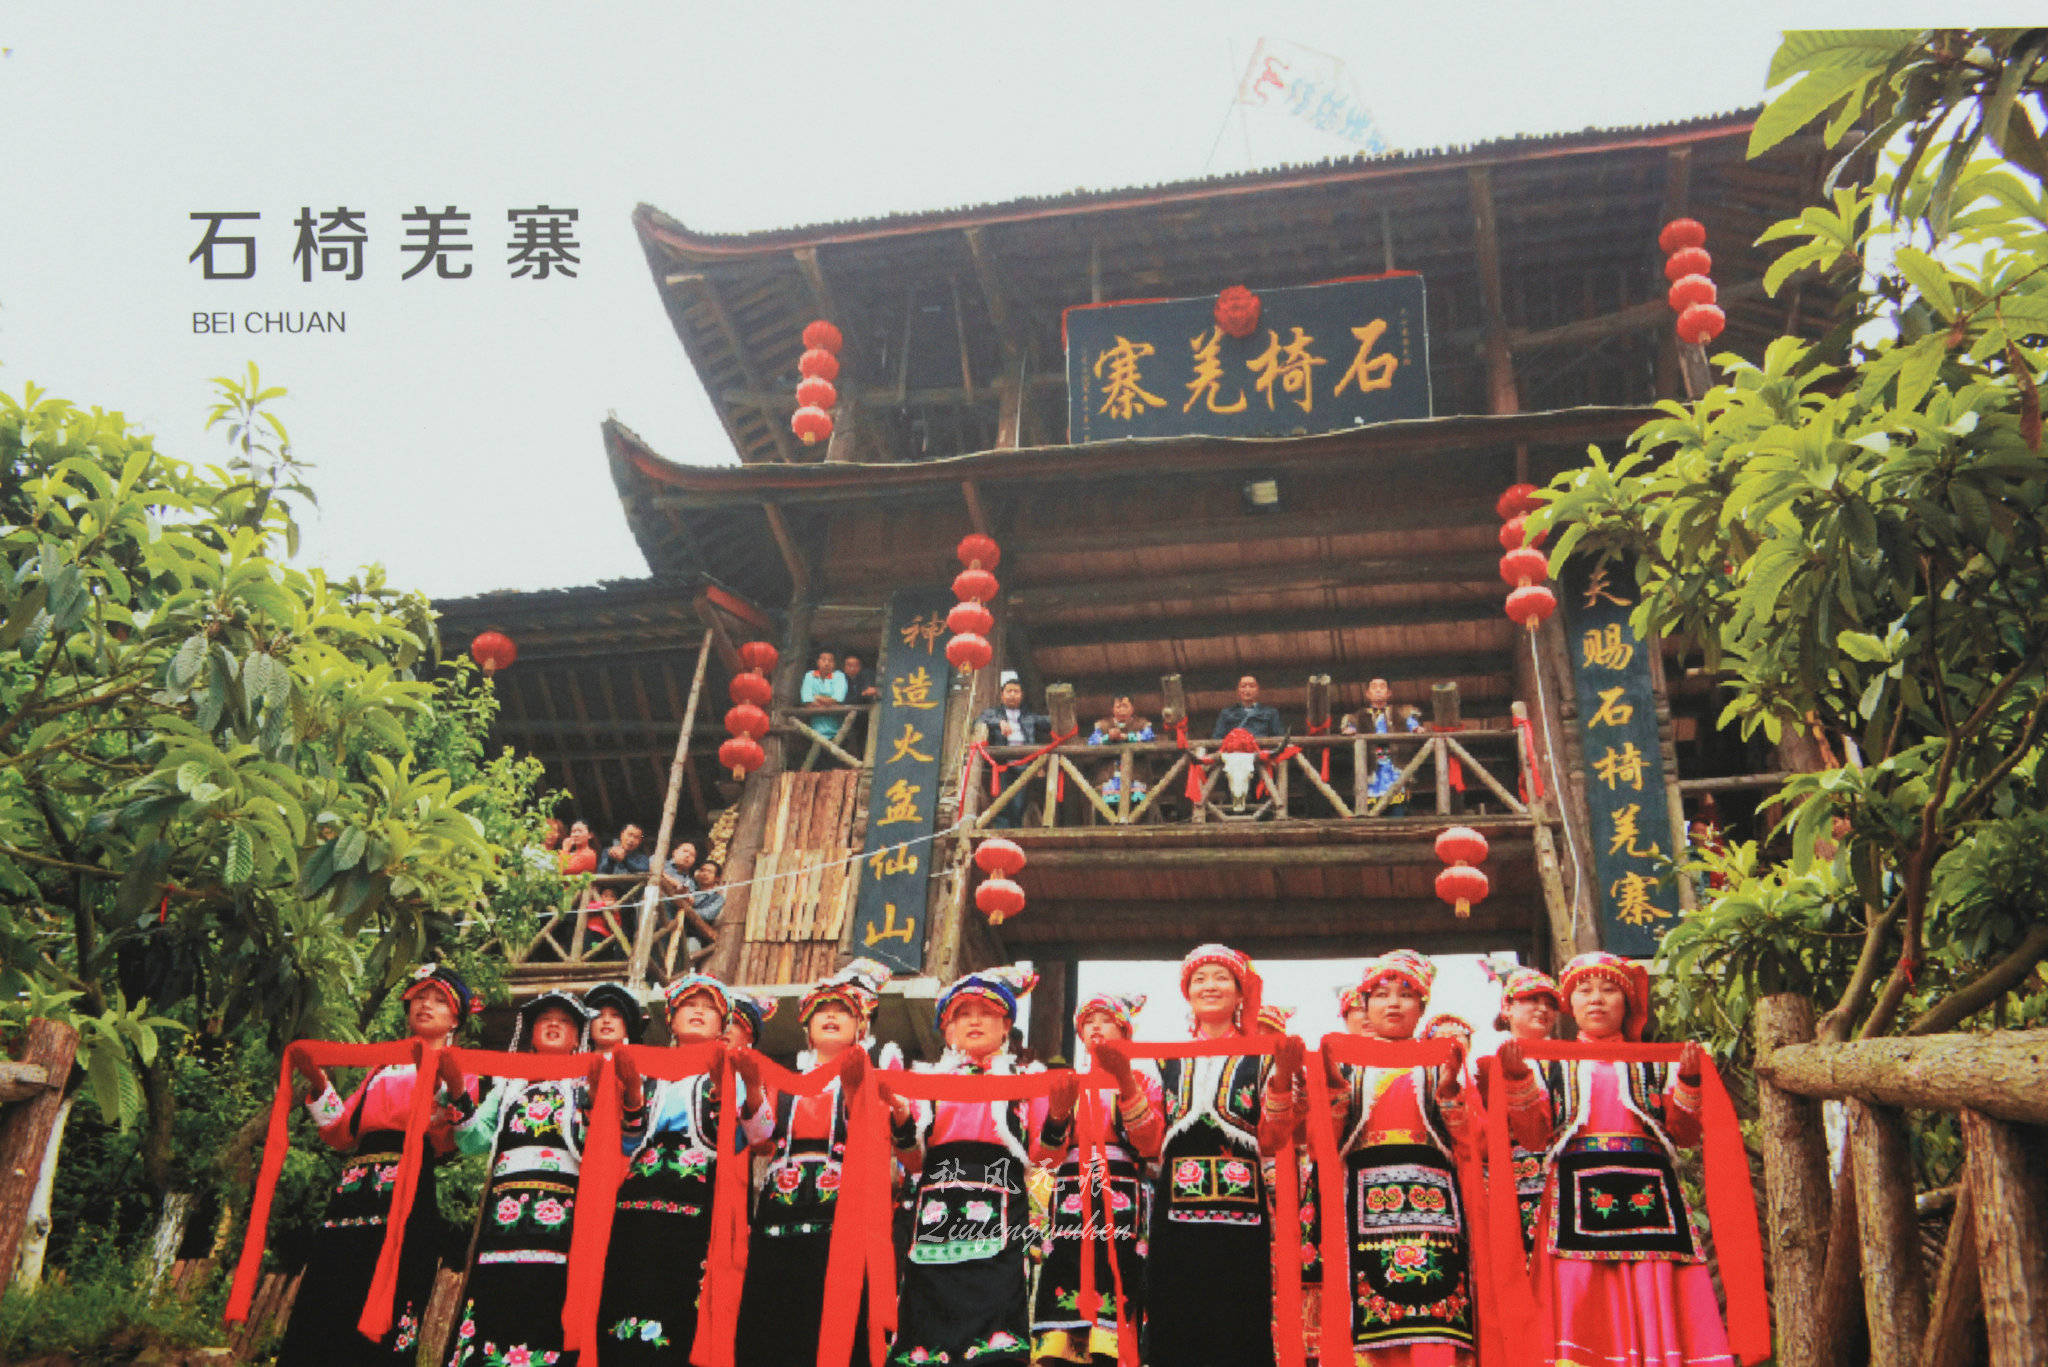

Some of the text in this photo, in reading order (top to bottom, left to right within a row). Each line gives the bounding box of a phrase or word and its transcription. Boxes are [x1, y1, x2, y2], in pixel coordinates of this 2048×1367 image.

[863, 610, 946, 948] 神造火盆仙山
